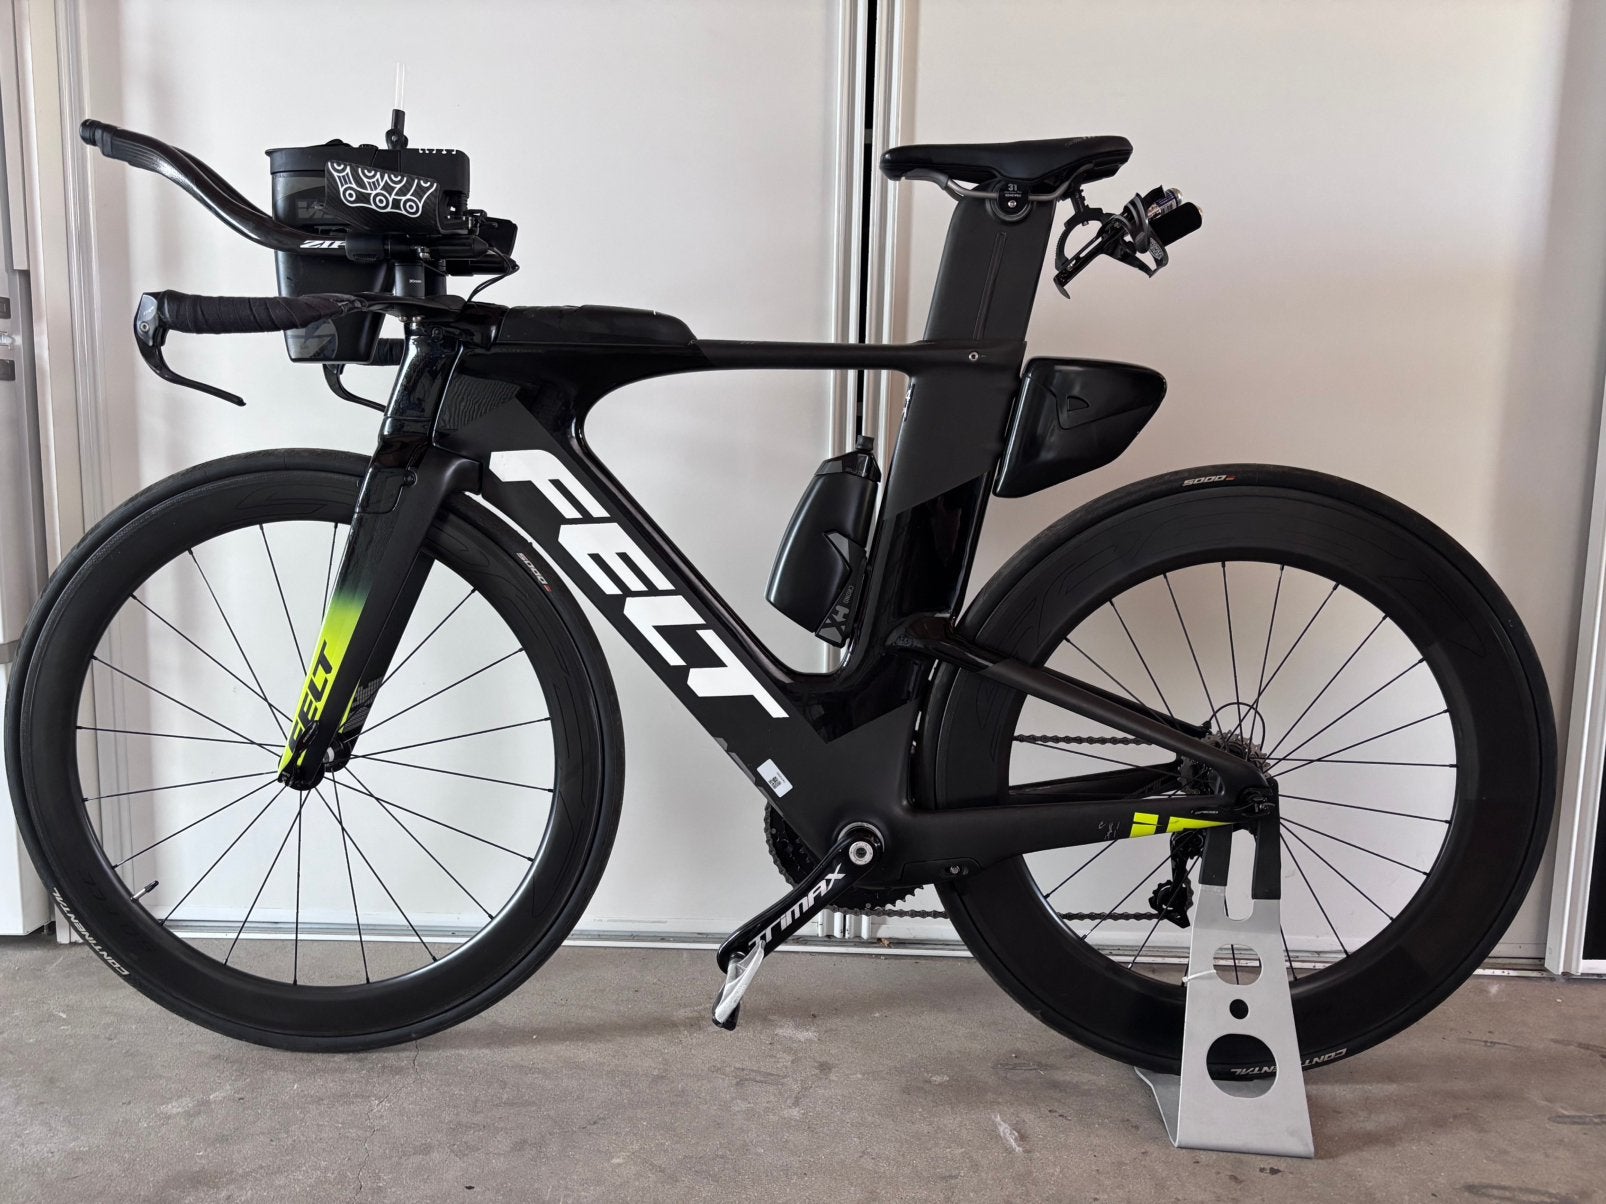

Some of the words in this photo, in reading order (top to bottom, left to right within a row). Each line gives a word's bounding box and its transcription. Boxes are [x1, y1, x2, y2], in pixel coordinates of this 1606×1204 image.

[489, 449, 789, 718] FELT
[289, 639, 333, 754] FELT
[52, 887, 130, 976] CONTINENTAL
